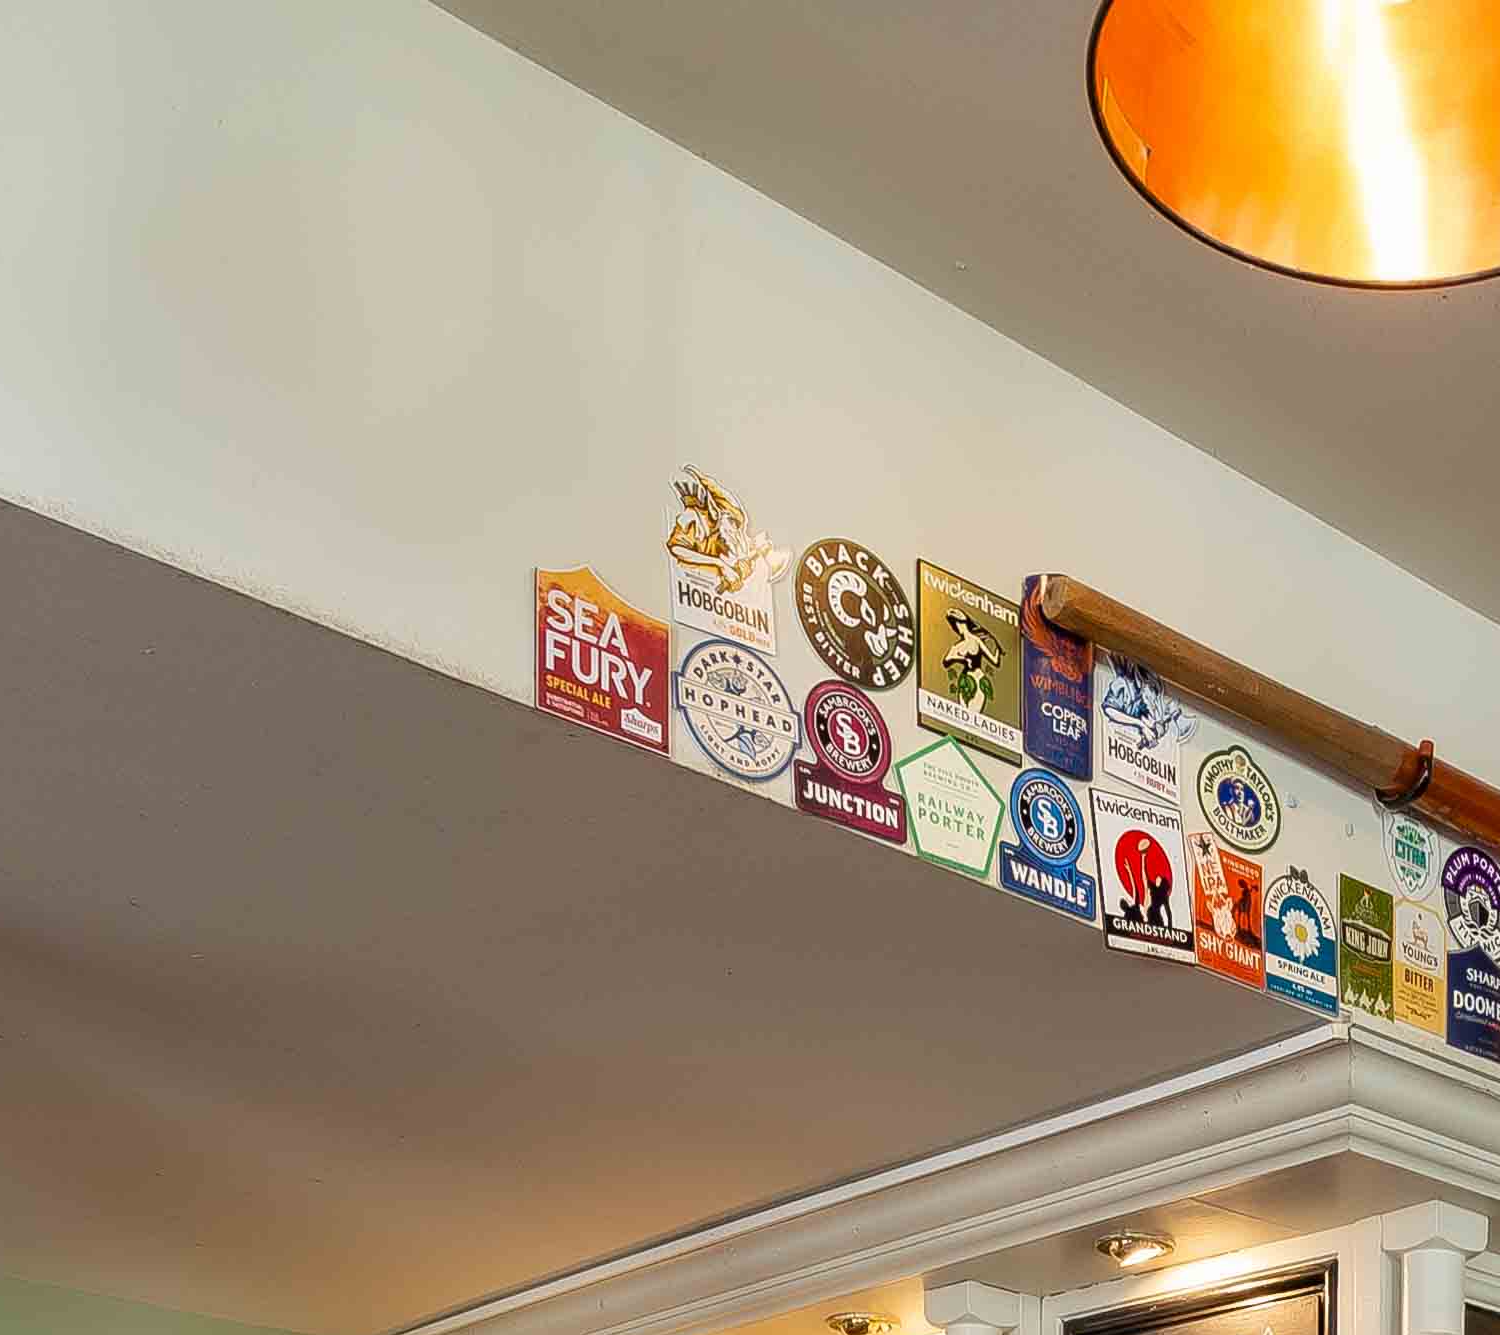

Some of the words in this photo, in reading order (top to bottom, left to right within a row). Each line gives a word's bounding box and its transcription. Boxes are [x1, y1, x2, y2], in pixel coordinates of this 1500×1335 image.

[677, 581, 769, 634] HOBGOBLIN
[805, 544, 891, 590] BLACK
[872, 601, 914, 687] SHEEP
[924, 570, 1019, 628] twickenham
[546, 588, 629, 657] SEA
[814, 631, 861, 680] BITTER
[545, 674, 591, 702] SPECIAL
[591, 693, 612, 710] ALE
[693, 650, 730, 679] DARK
[746, 662, 781, 705] STAR
[684, 687, 793, 734] HOPHEAD
[925, 695, 972, 723] NAKED
[972, 713, 1016, 742] LADIES
[1041, 702, 1087, 734] COPPER
[1052, 719, 1081, 740] LEAF
[825, 742, 874, 771] BREWERY
[1108, 735, 1178, 786] HOBGOBLIN
[802, 779, 900, 830] JUNCTION
[917, 791, 986, 823] RAILWAY
[1204, 758, 1235, 795] TIMOTHY
[1245, 766, 1275, 823] TAYLOR'S
[917, 806, 987, 841] PORTER
[1095, 795, 1180, 831] twickenham
[1026, 827, 1069, 856] BREWERY
[1010, 860, 1089, 908] WANDLE
[1203, 876, 1225, 894] IPA
[1444, 853, 1470, 882] PLUM
[1268, 880, 1331, 930] TWICKENHAM
[1112, 917, 1188, 944] GRANDSTAND
[1344, 928, 1366, 951] KING
[1199, 932, 1223, 952] SHY
[1224, 943, 1262, 970] GIANT
[1401, 942, 1439, 968] YOUNG'S
[1278, 960, 1309, 976] SPRING
[1310, 972, 1325, 984] ALE
[1404, 968, 1435, 992] BITTER
[1452, 990, 1496, 1018] DOOM
